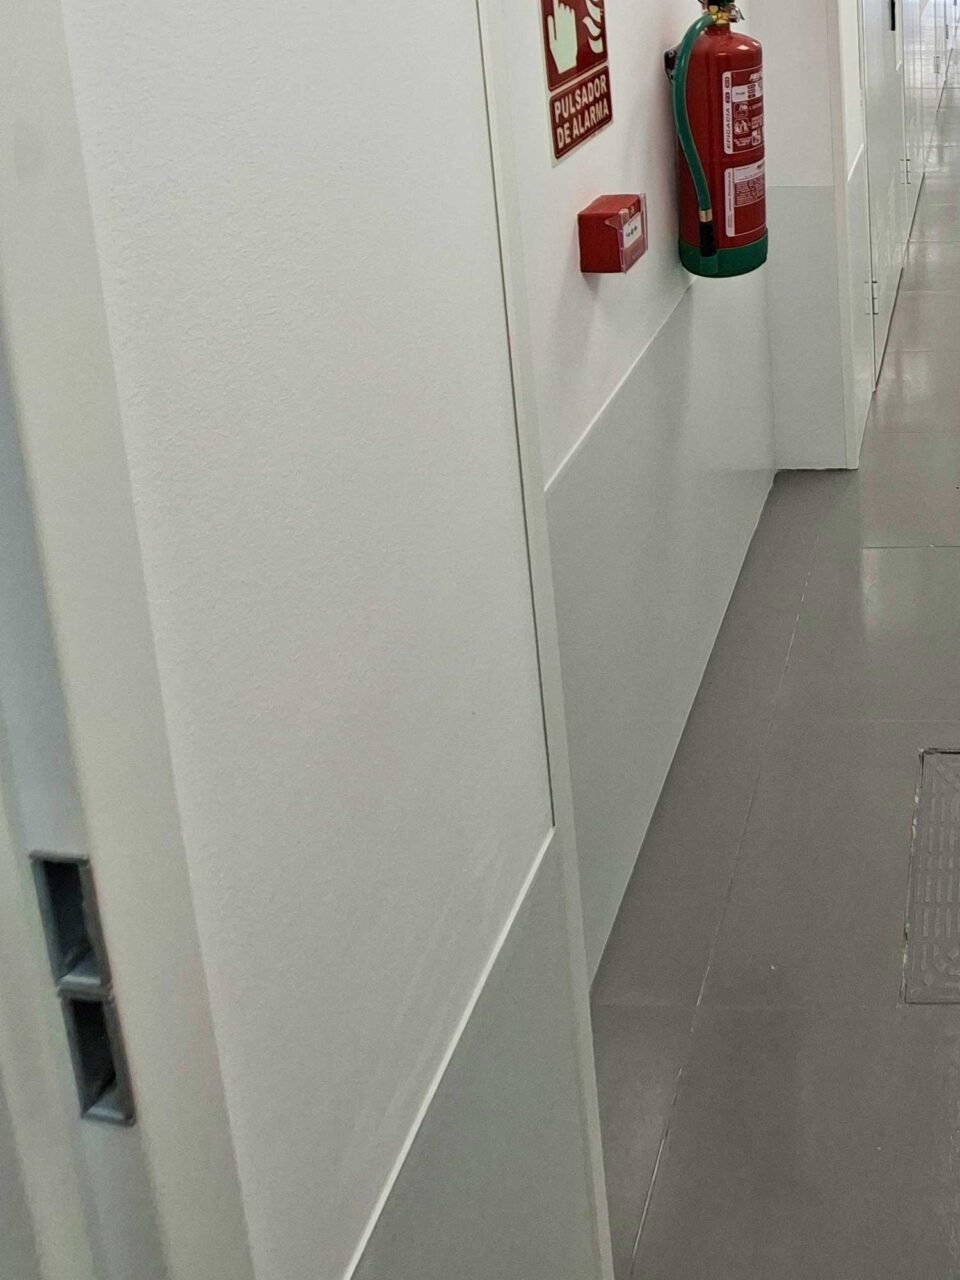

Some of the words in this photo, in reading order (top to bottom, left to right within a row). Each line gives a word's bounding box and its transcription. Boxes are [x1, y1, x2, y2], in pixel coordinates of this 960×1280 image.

[554, 74, 607, 123] PULSADOR
[556, 122, 571, 149] DE
[573, 98, 609, 139] ALARMA
